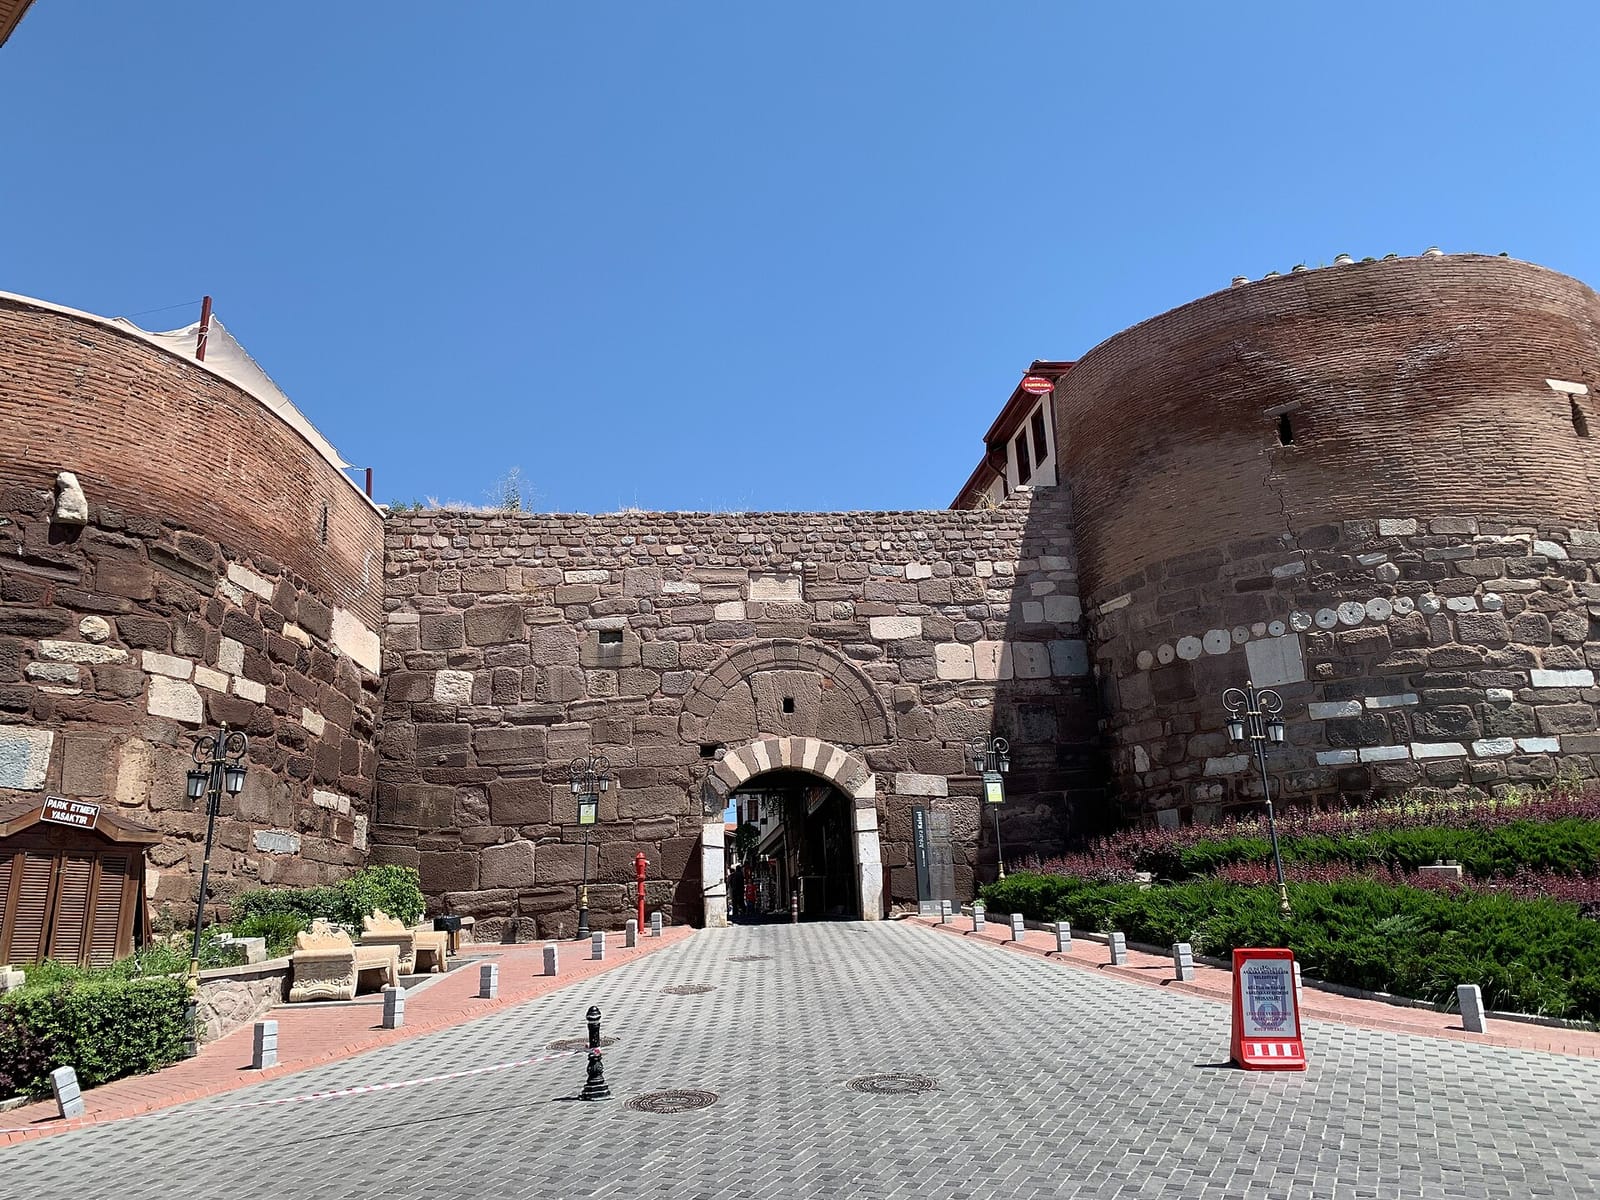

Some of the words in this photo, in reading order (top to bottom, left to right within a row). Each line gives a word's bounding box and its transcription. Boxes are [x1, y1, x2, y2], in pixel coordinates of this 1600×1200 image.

[47, 799, 69, 811] PARK
[70, 803, 98, 816] ETMEK
[51, 810, 88, 825] YASAKTIR
